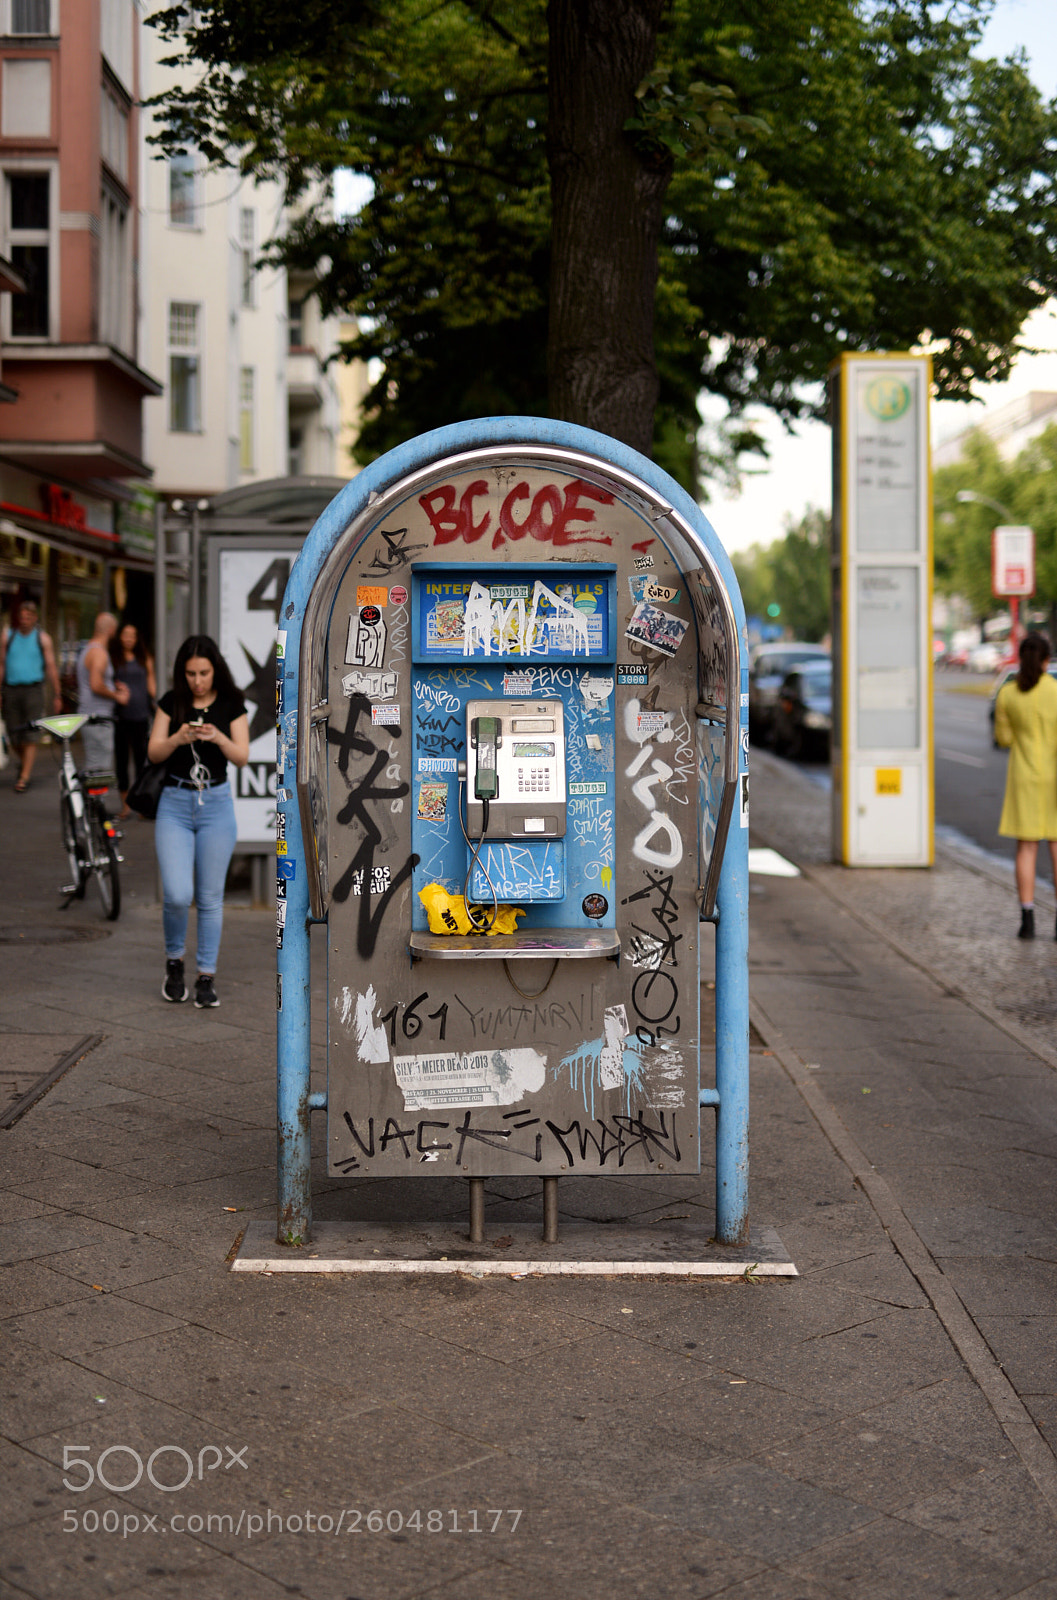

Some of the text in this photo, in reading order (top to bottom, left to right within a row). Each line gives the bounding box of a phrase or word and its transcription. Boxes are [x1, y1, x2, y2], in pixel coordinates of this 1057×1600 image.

[618, 665, 648, 675] STORY
[621, 675, 646, 684] 3000
[381, 991, 449, 1047] 161
[422, 1058, 446, 1074] MEIER
[470, 1055, 489, 1069] 2013
